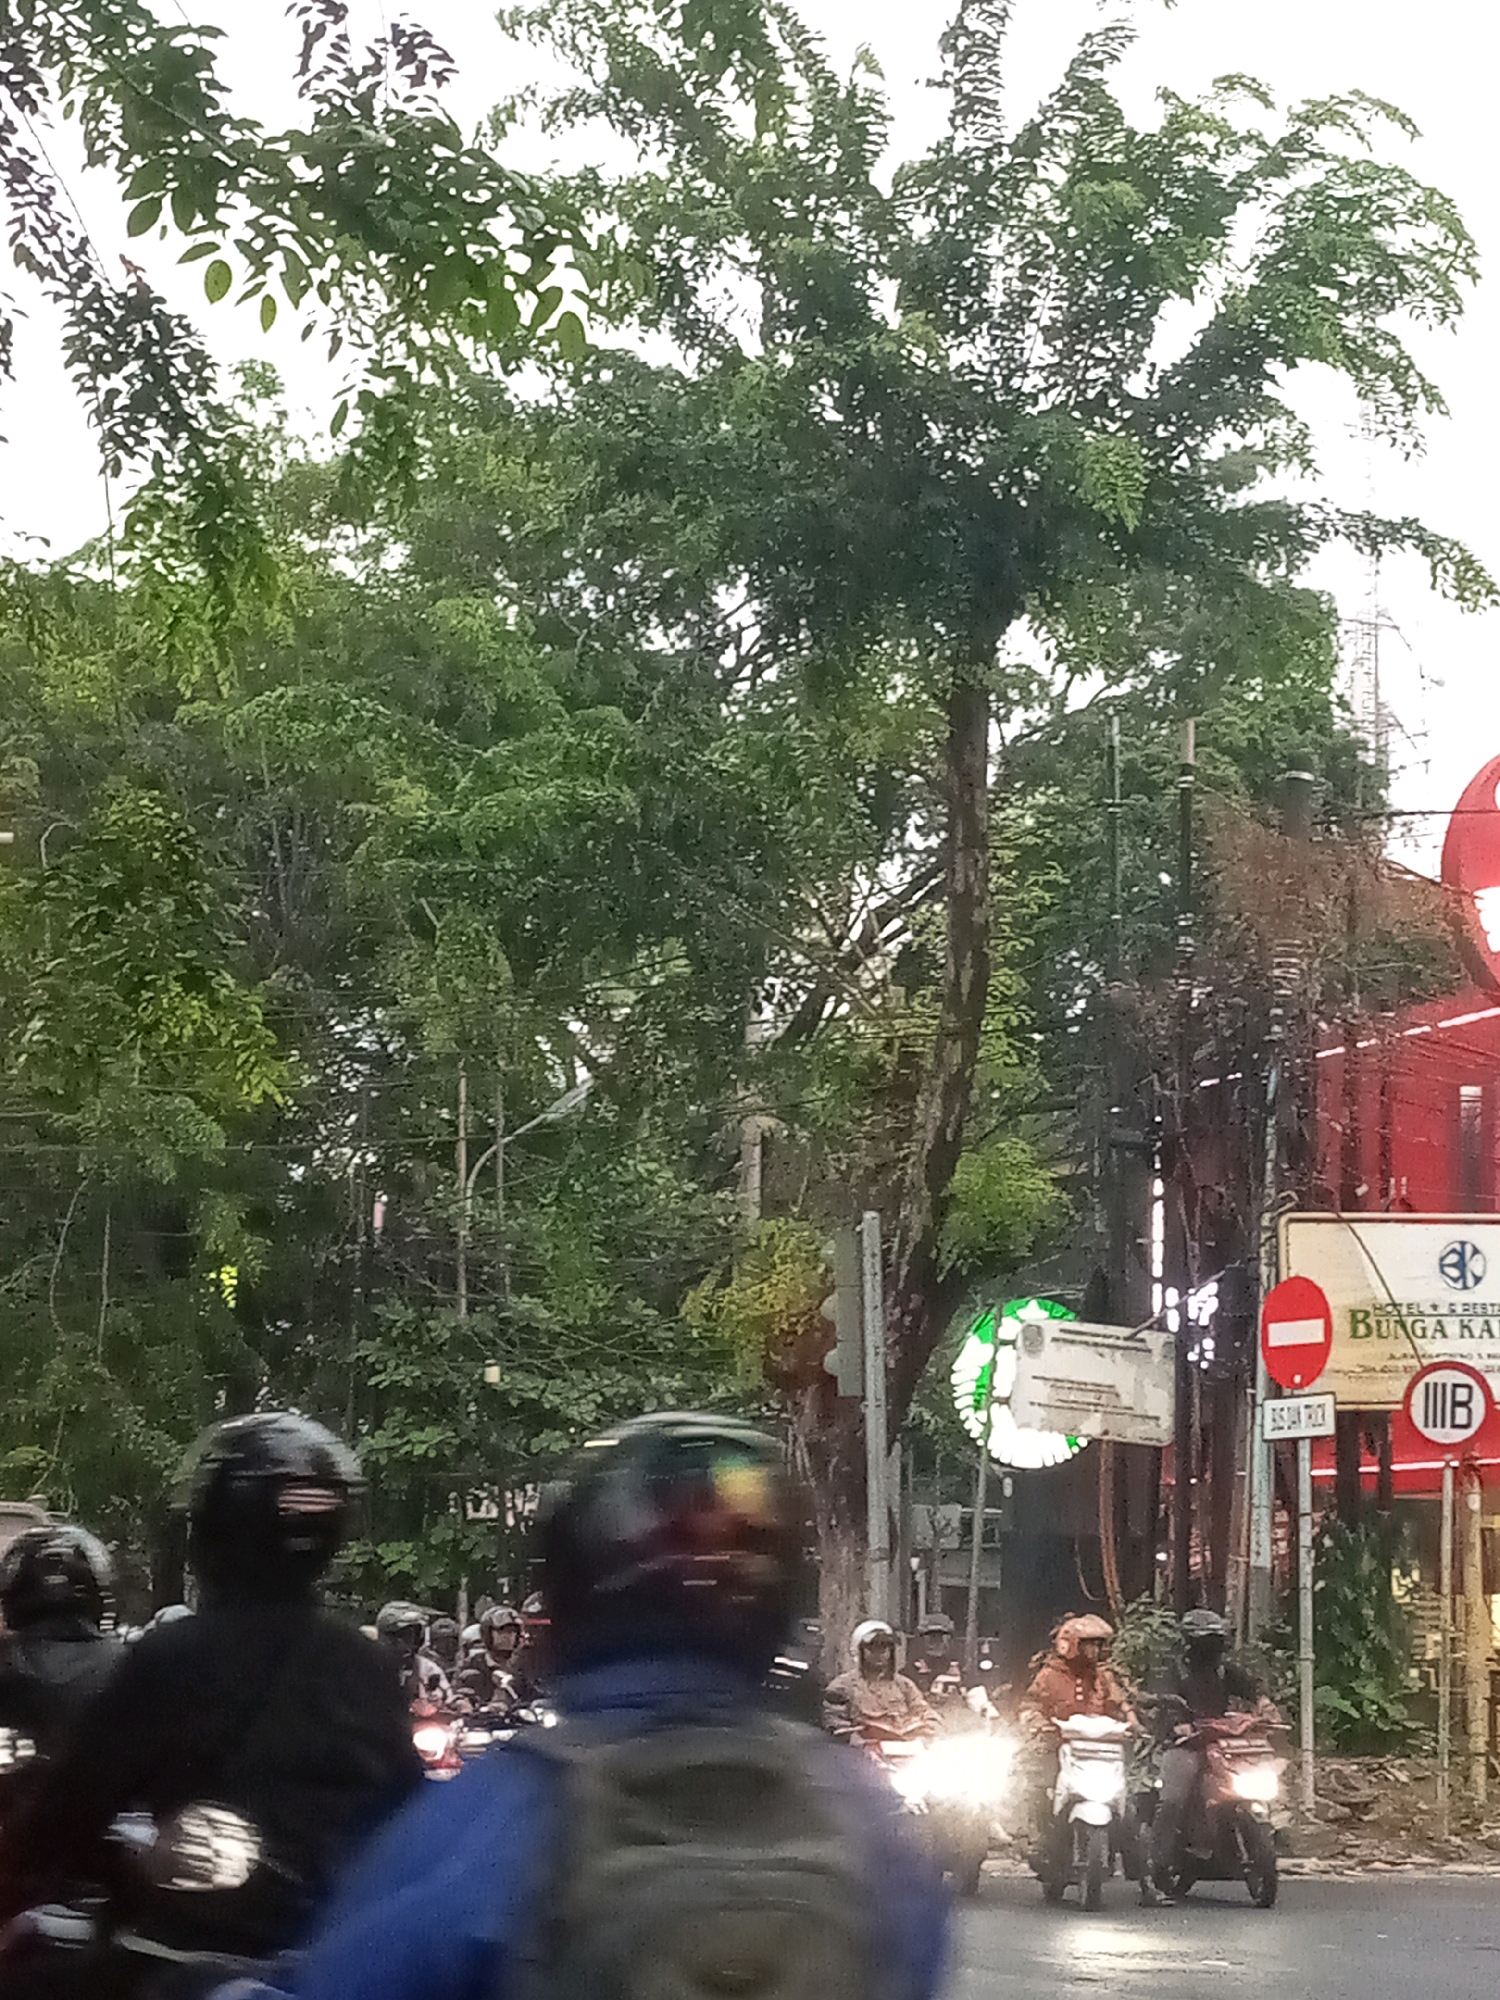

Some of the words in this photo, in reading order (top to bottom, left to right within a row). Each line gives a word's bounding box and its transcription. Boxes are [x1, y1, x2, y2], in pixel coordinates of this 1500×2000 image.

[1373, 1302, 1424, 1315] HOTEL
[1349, 1309, 1449, 1340] BUNGA
[1459, 1318, 1500, 1340] KA
